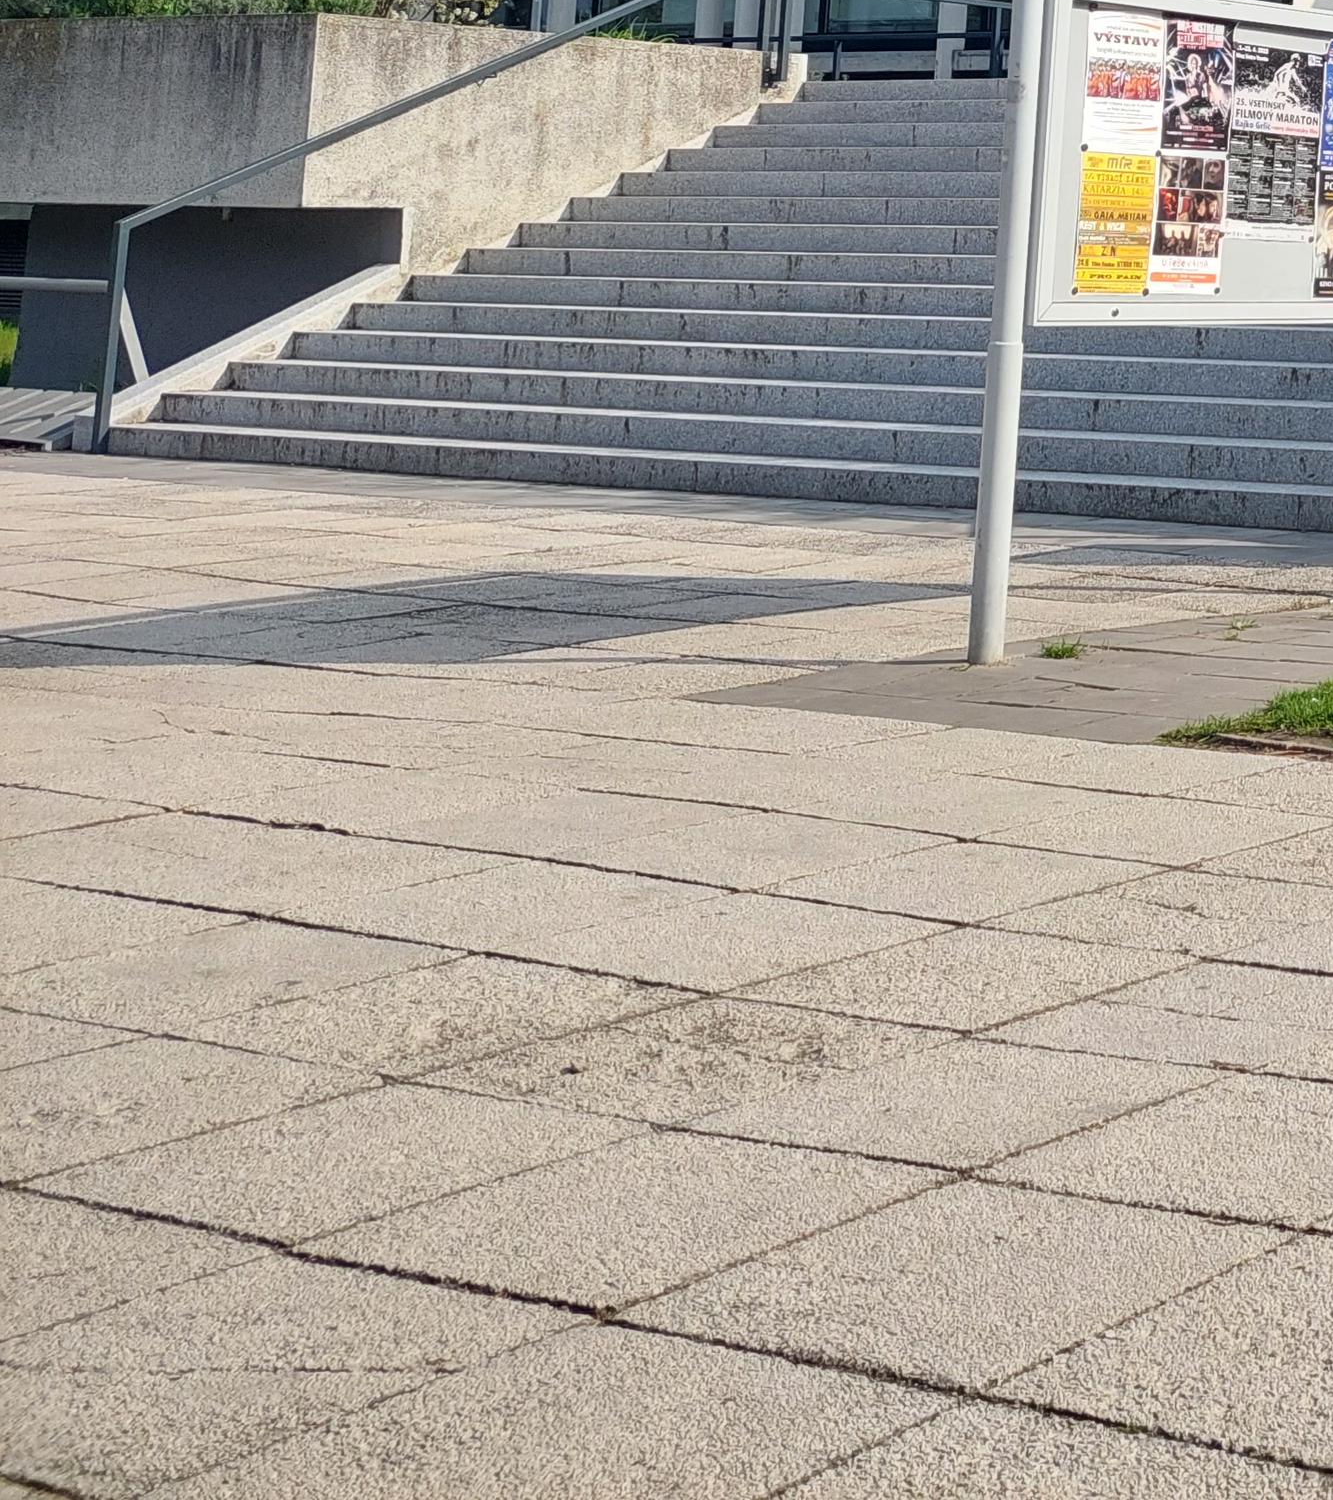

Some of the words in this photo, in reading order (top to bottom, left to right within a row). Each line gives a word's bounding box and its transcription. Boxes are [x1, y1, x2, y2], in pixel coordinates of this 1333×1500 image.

[1093, 31, 1160, 47] VÝSTAVY
[1236, 97, 1247, 107] 25.
[1235, 108, 1274, 121] FILMOVÝ
[1276, 112, 1318, 126] MARATON
[1116, 273, 1143, 281] PAIN
